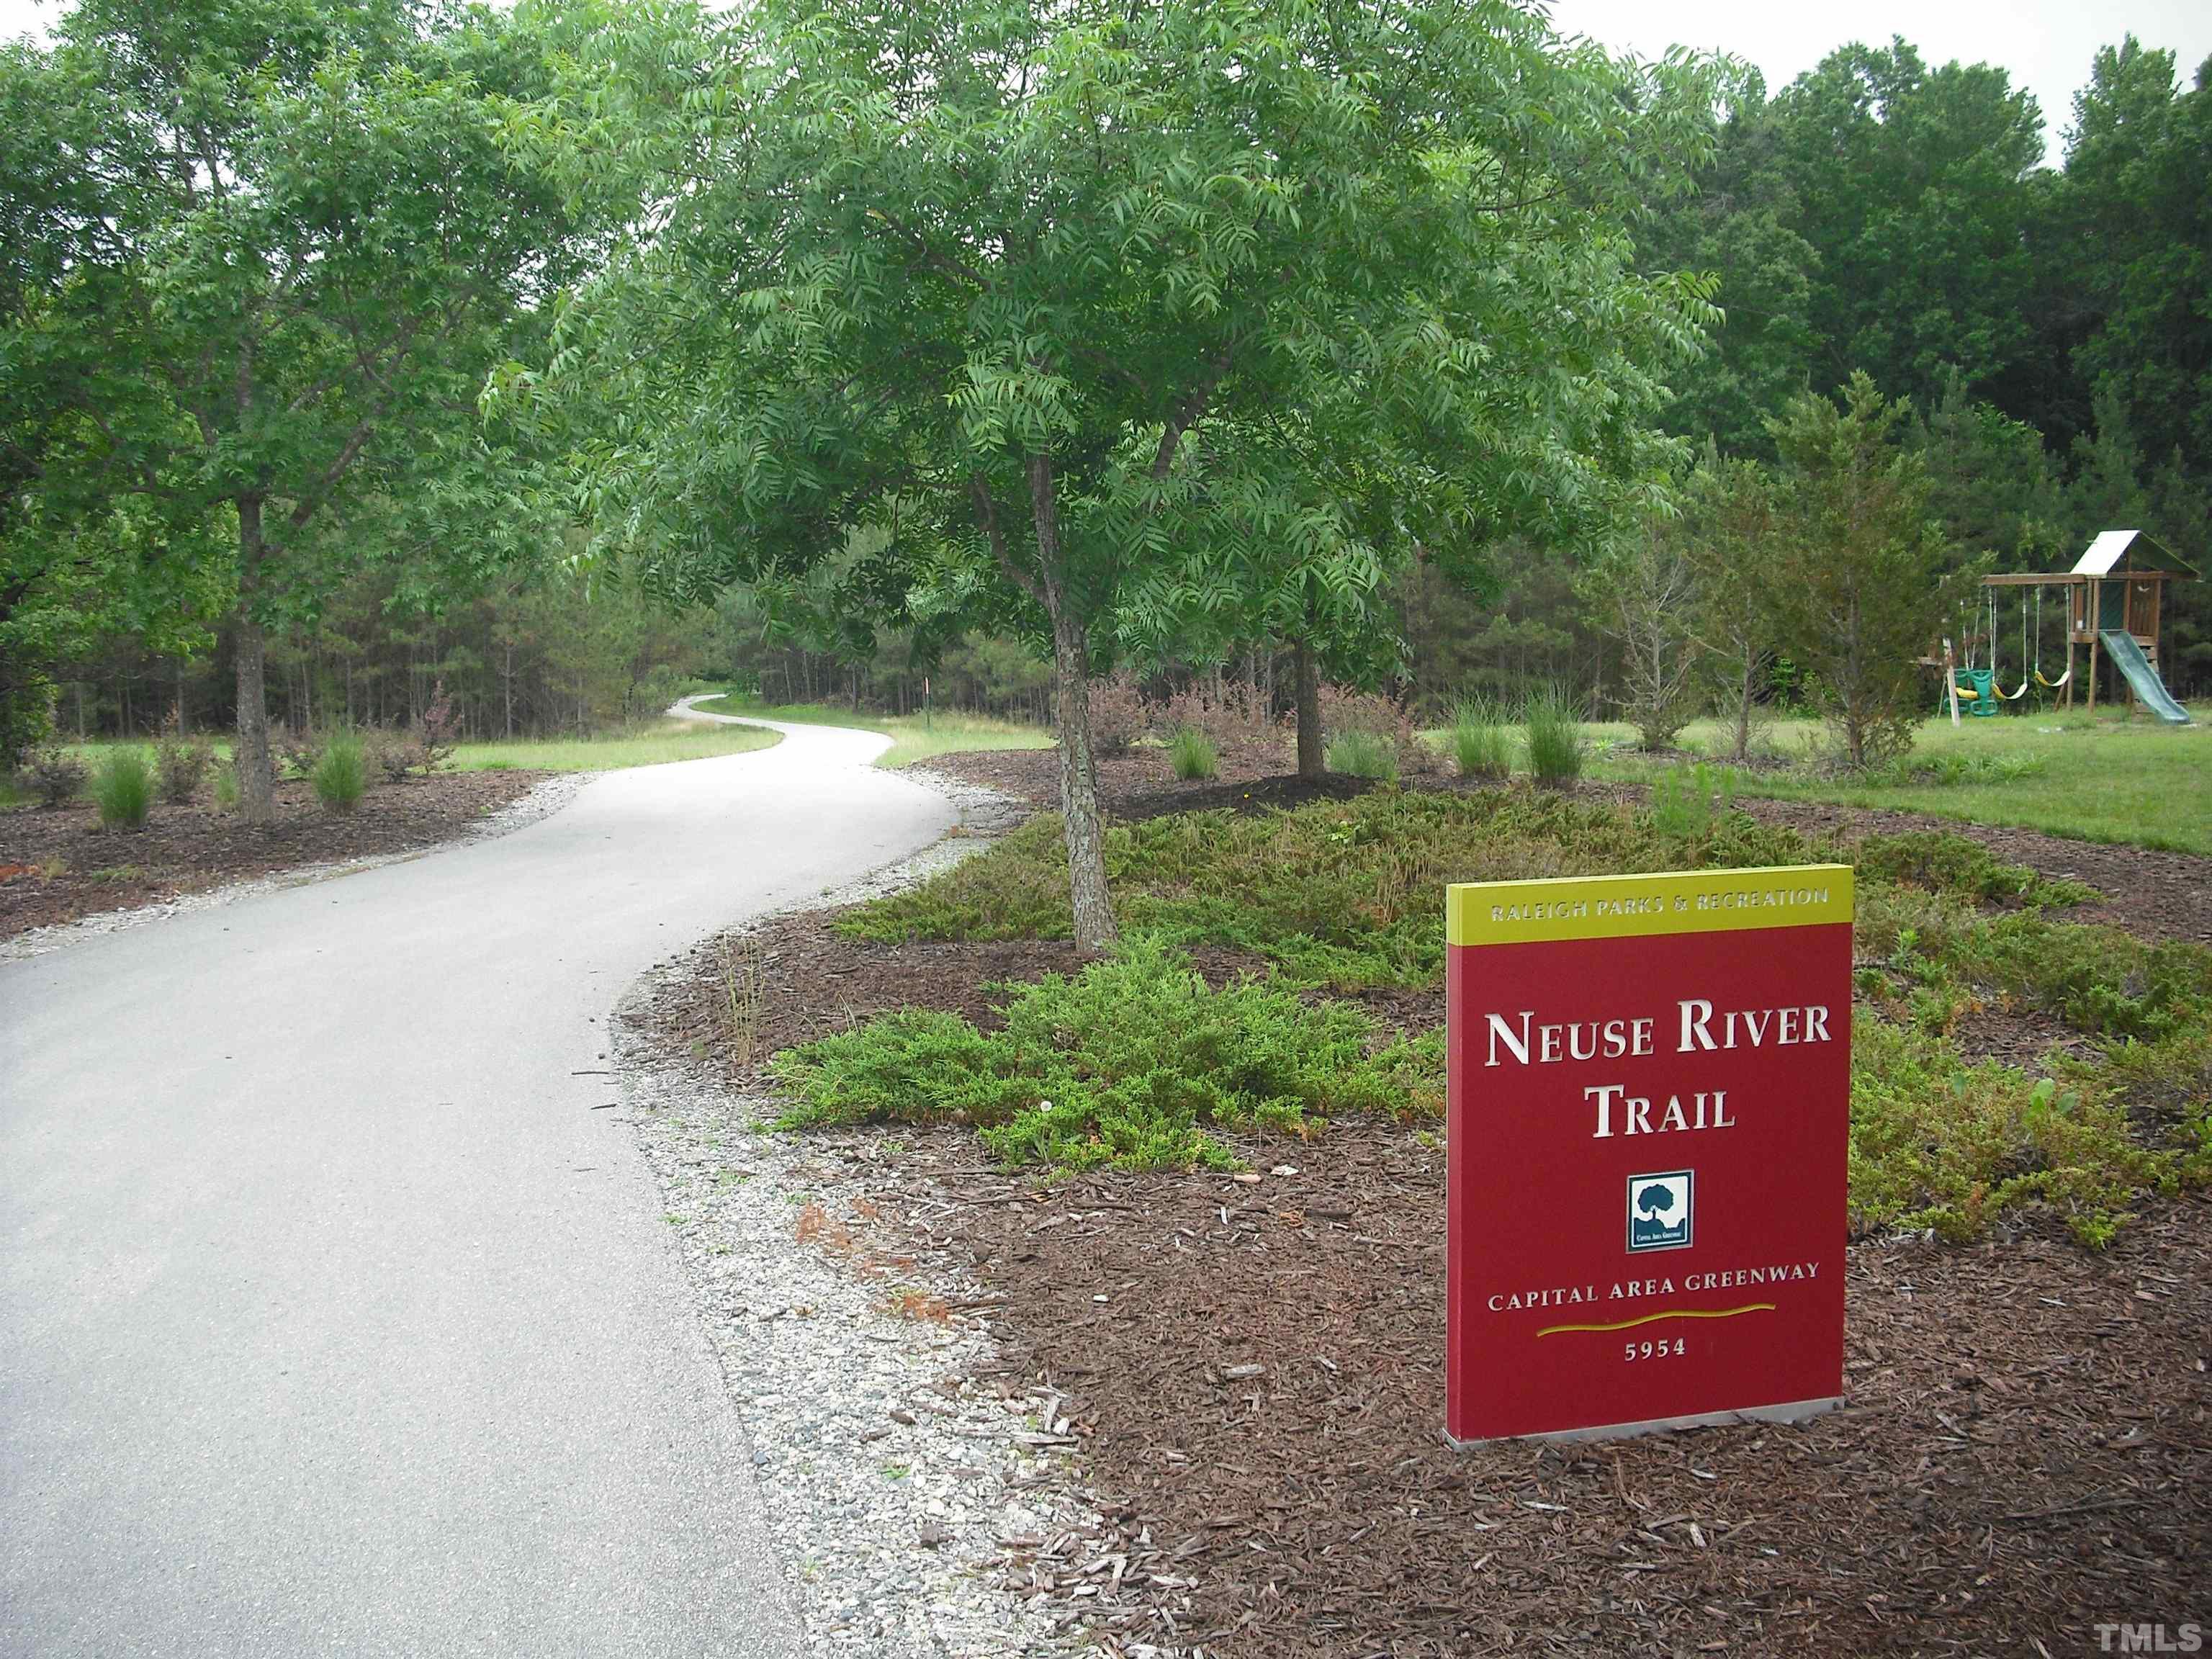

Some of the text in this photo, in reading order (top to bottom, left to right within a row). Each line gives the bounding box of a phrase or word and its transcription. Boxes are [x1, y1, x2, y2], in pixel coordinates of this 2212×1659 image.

[1491, 887, 1830, 922] RALEIGH PARKS & RECREATION
[1484, 999, 1832, 1067] NEUSE RIVER
[1584, 1084, 1735, 1138] TRAIL
[1488, 1262, 1820, 1311] CAPITAL AREA GREENWAY
[1624, 1337, 1686, 1362] 5954
